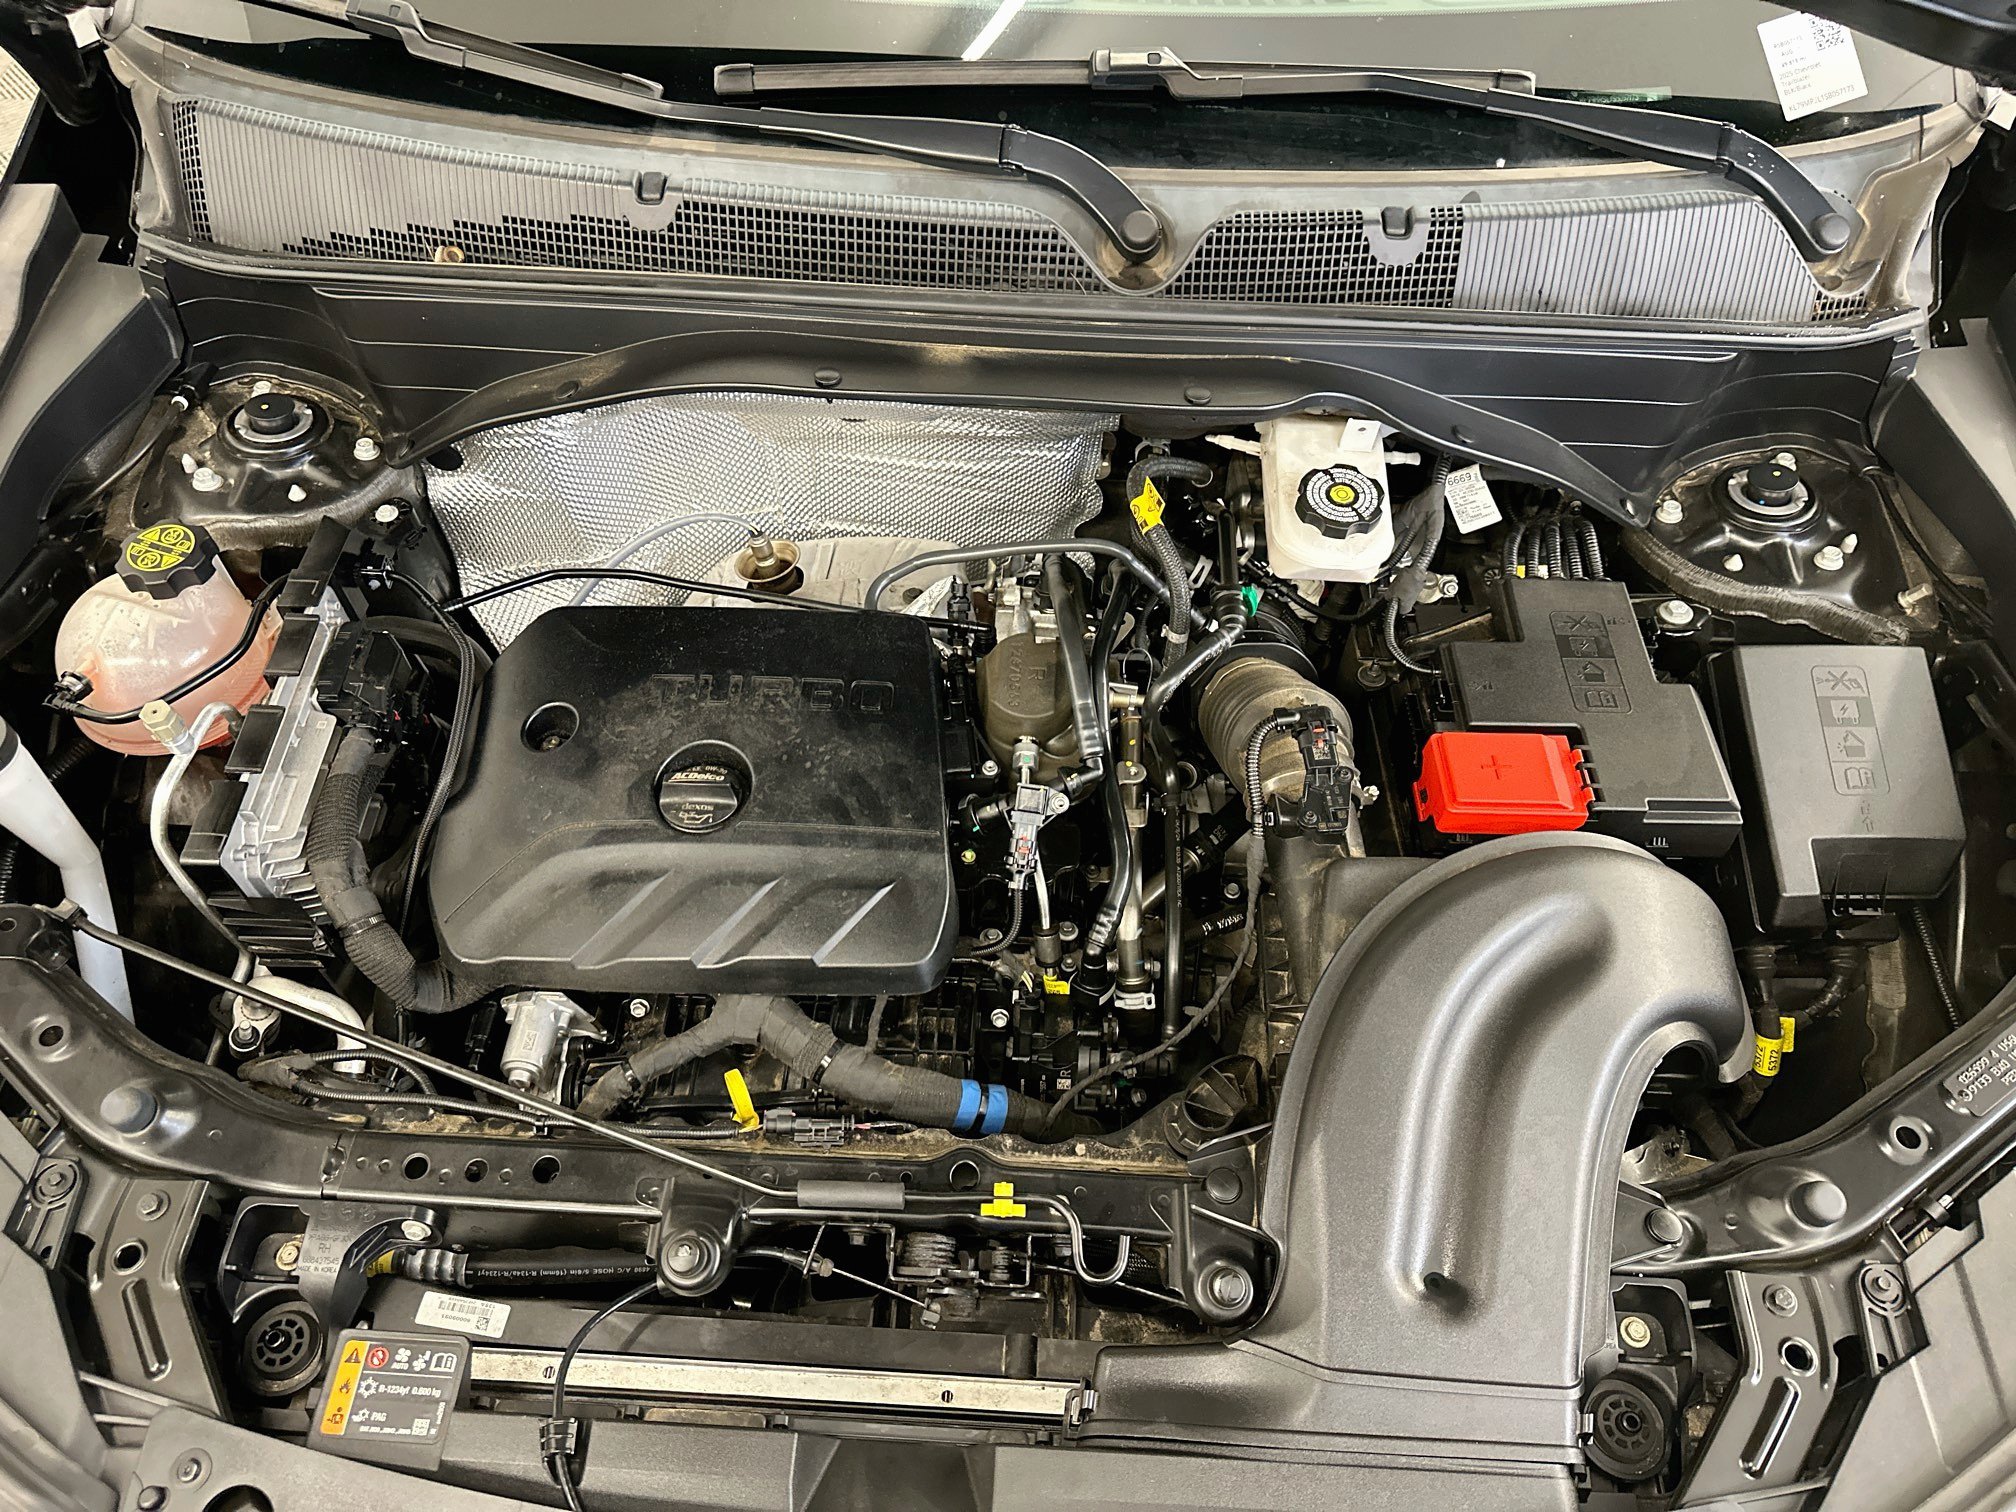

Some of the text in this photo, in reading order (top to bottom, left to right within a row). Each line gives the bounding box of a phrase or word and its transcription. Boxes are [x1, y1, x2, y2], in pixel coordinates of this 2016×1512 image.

[1446, 471, 1472, 486] 6669
[651, 673, 895, 713] TURBO
[705, 765, 727, 774] 0W-20
[670, 772, 724, 780] ACDelco
[1768, 1049, 1779, 1071] 5372
[318, 1242, 331, 1253] RH
[539, 1266, 566, 1277] (16mm)
[592, 1265, 614, 1275] HOSE
[390, 1361, 409, 1371] AUTO
[377, 1381, 411, 1397] R-1234yf
[431, 1386, 442, 1398] kg
[370, 1410, 387, 1422] PAG
